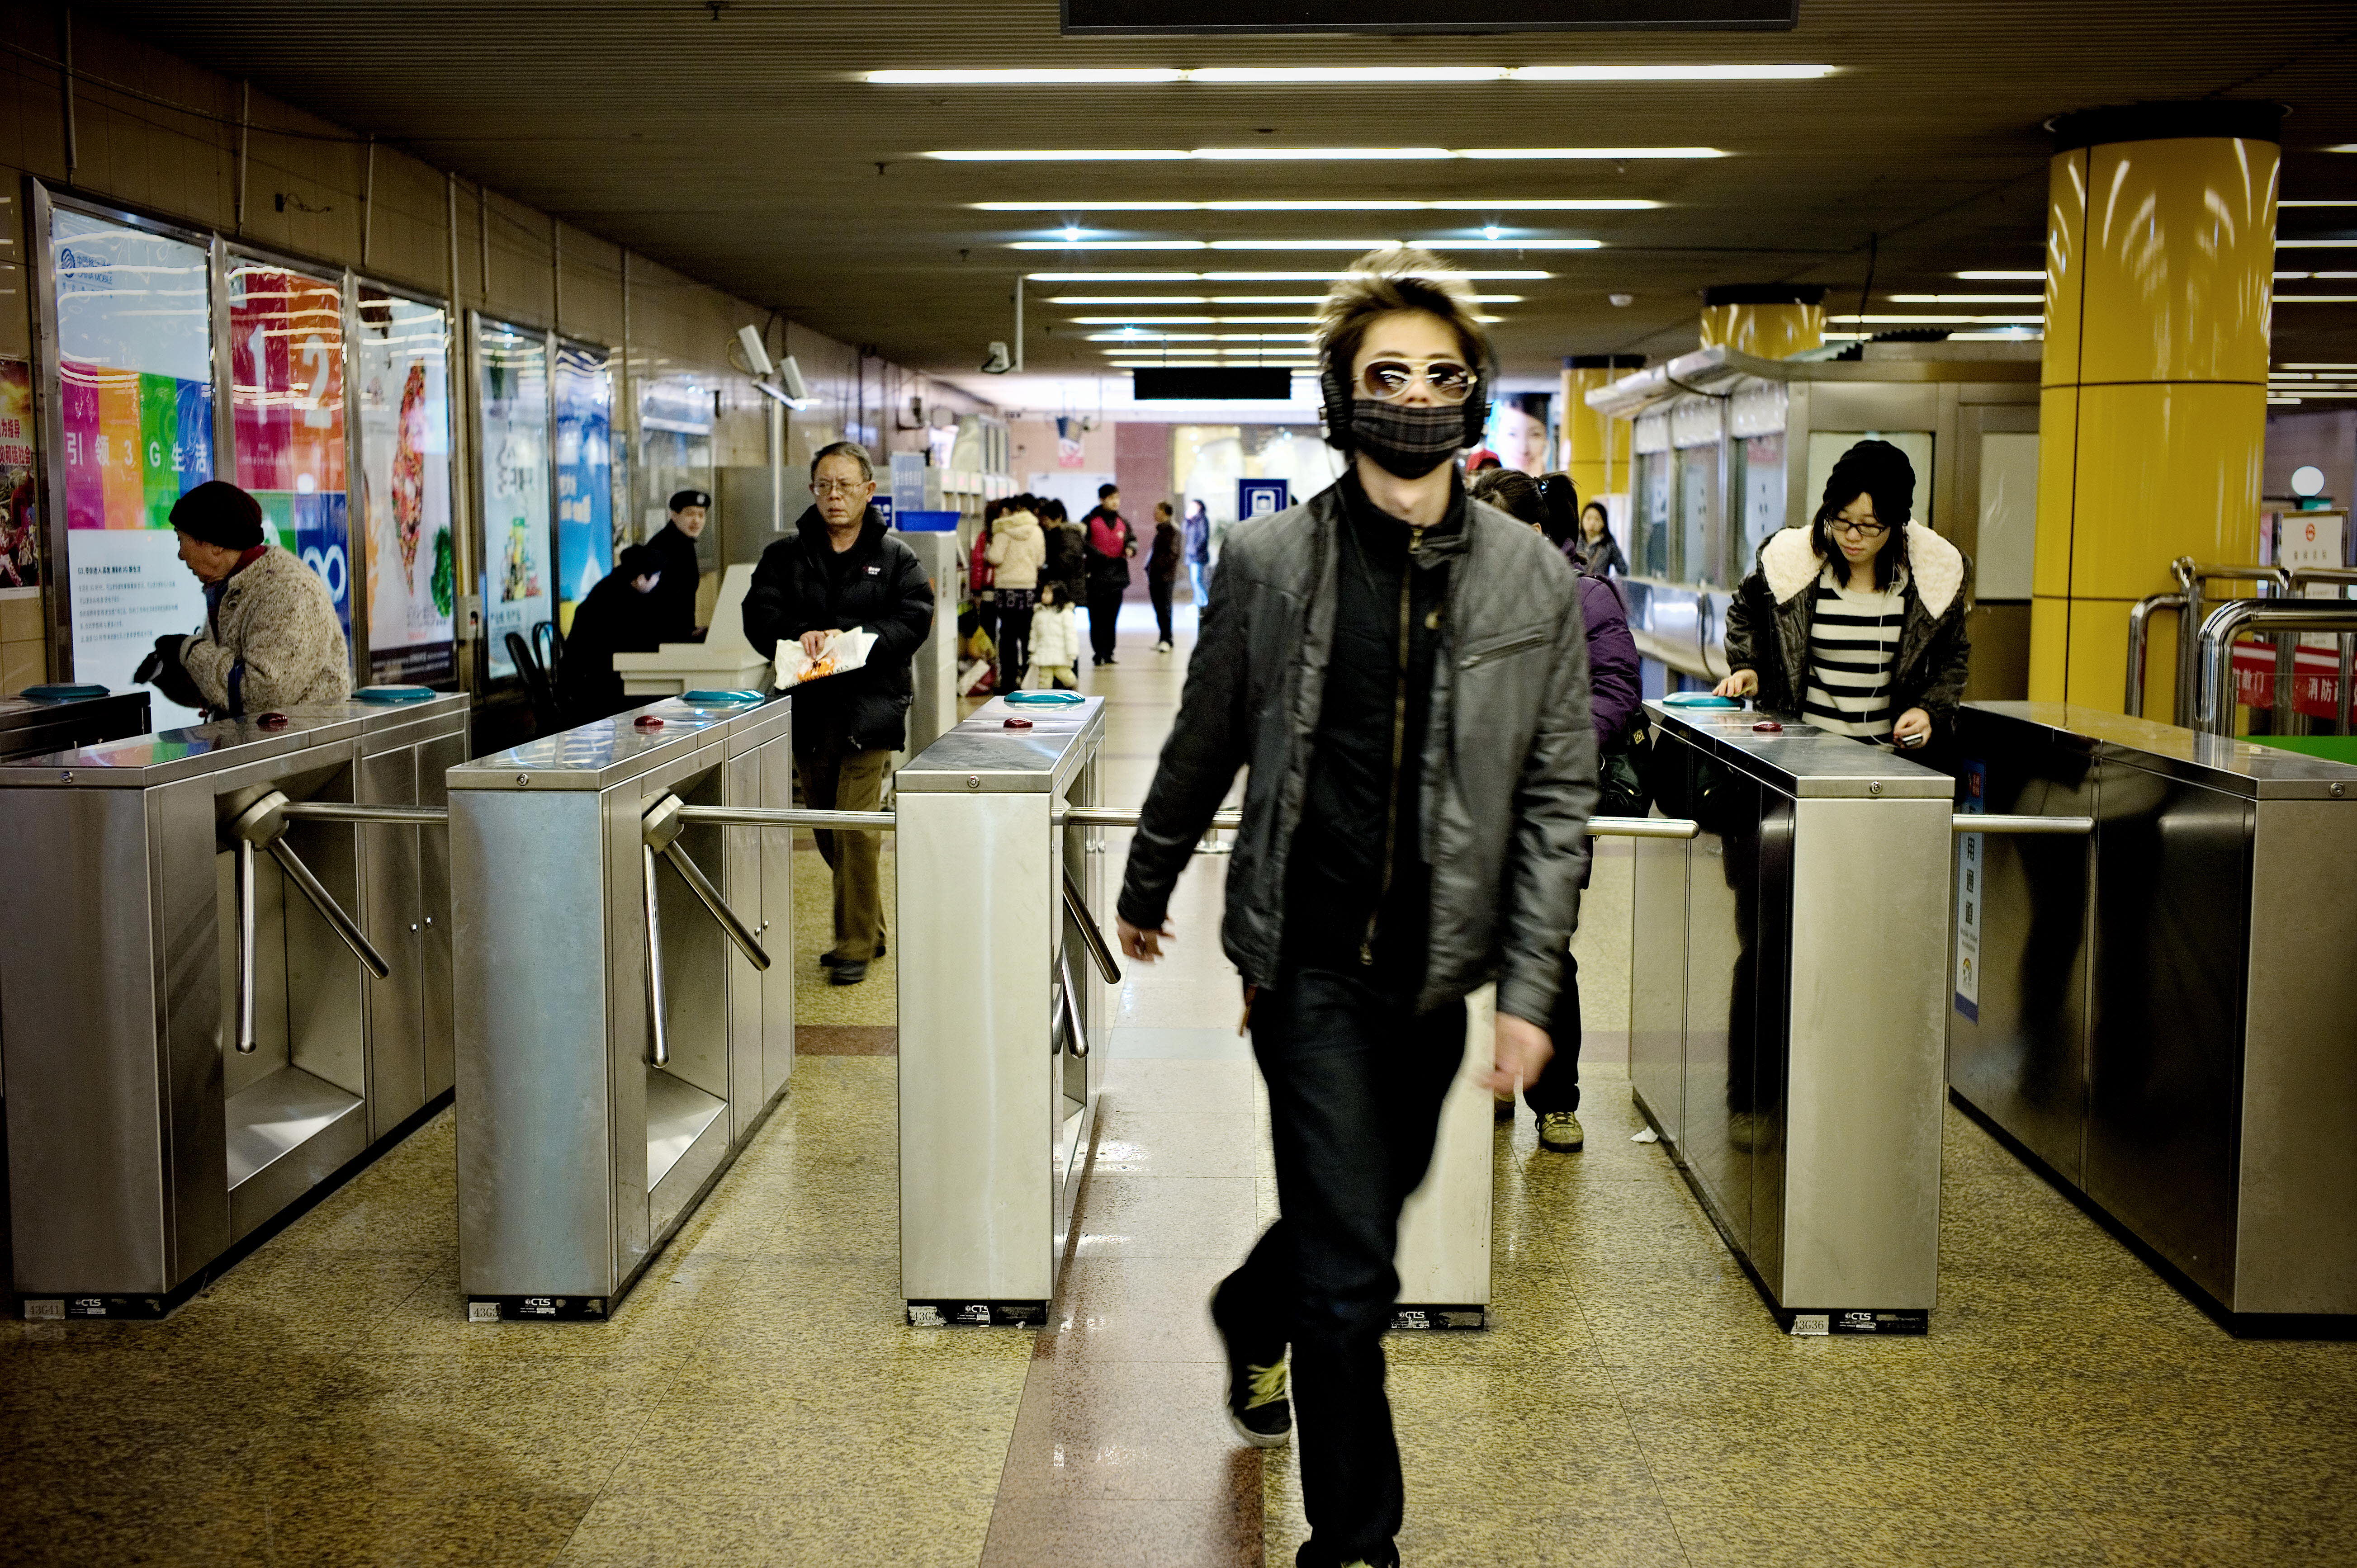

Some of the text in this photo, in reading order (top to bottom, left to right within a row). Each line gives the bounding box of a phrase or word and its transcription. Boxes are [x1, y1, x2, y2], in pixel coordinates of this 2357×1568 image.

[0, 418, 20, 439] 为指导
[66, 432, 207, 473] 引领3G生活
